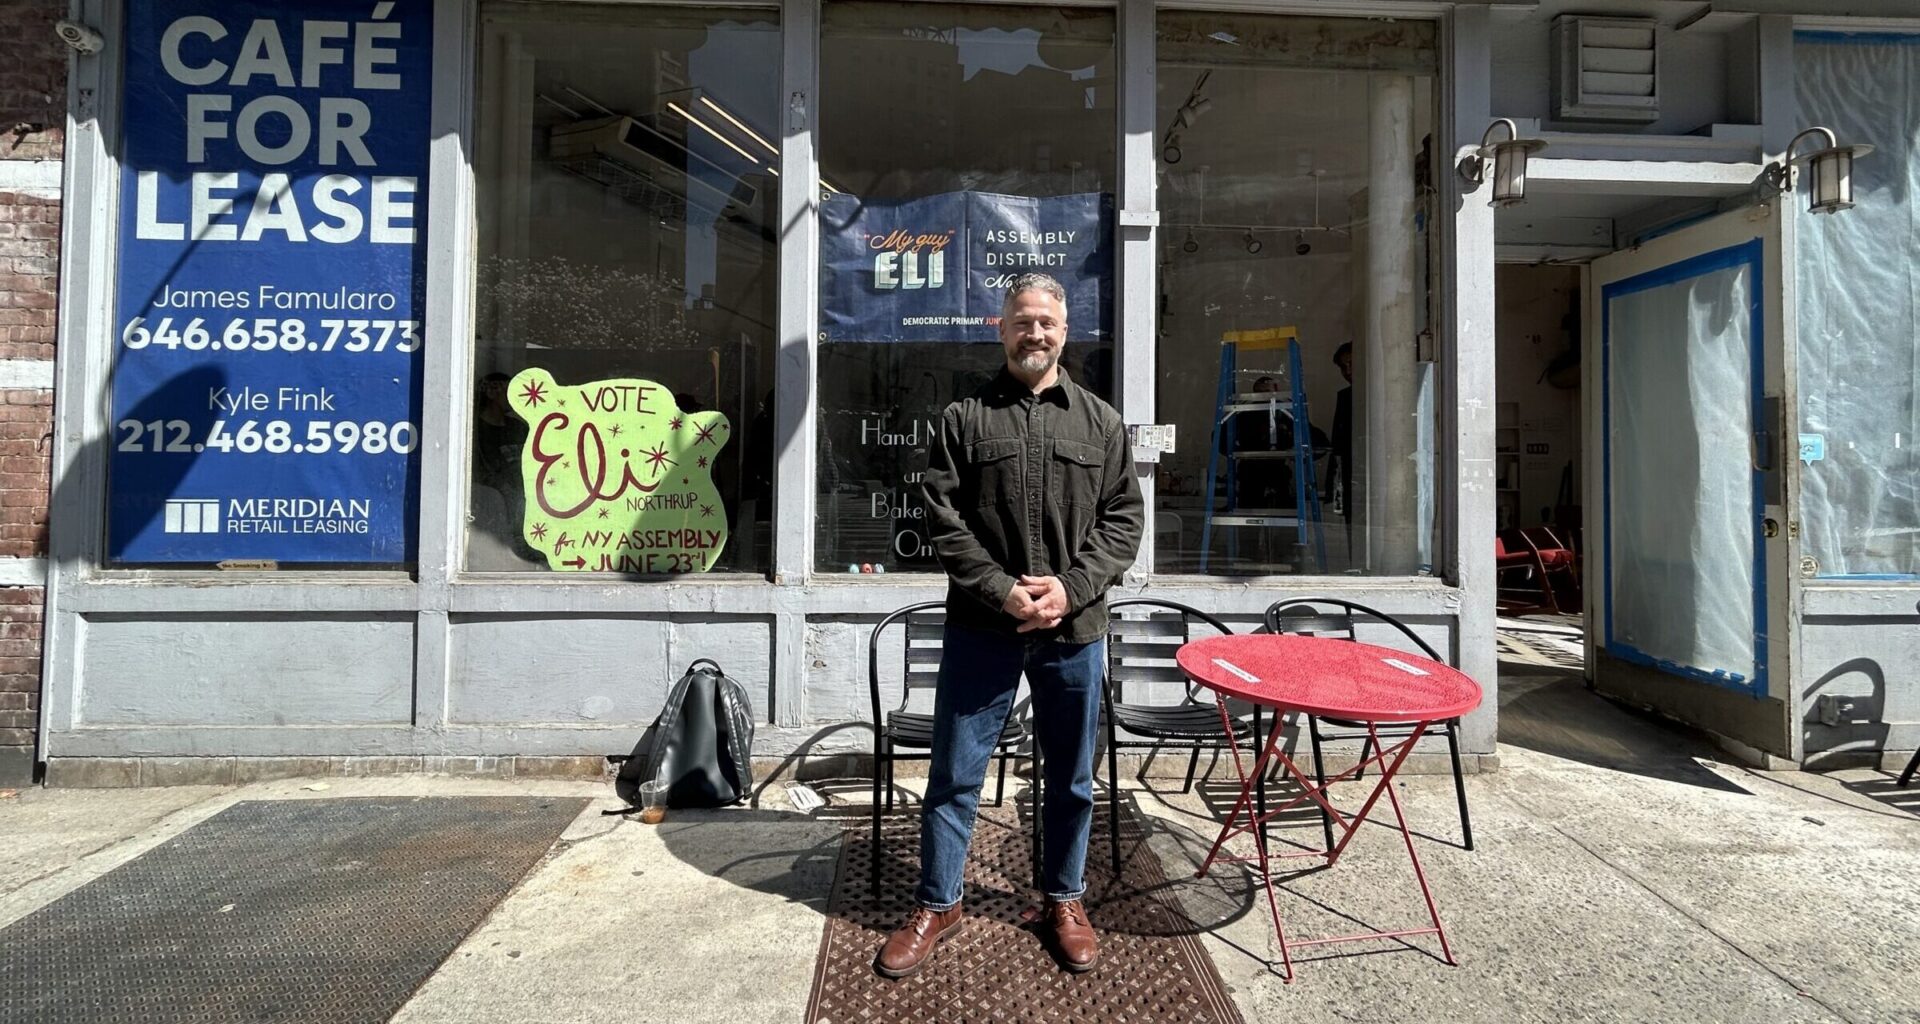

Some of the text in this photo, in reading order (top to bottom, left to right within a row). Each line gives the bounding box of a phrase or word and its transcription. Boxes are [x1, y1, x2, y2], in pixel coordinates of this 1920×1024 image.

[160, 2, 401, 90] CAFÉ
[186, 94, 377, 167] FOR
[136, 170, 417, 244] LEASE
[986, 230, 1076, 245] ASSEMBLY
[874, 250, 944, 290] ELI
[986, 252, 1067, 267] DISTRICT
[153, 286, 396, 311] James Famularo
[122, 317, 420, 353] 646.658.7373
[902, 316, 950, 327] DEMOCRATIC
[951, 316, 984, 326] PRIMARY
[209, 387, 335, 415] Kyle Fink
[580, 386, 657, 415] VOTE
[118, 420, 418, 455] 212.468.5980
[861, 418, 917, 446] Hand
[532, 412, 662, 520] Eli
[227, 499, 370, 519] MERIDIAN
[626, 492, 698, 513] NORTHRUP
[872, 492, 927, 519] Bake
[227, 519, 369, 534] RETAIL LEASING
[554, 529, 720, 556] for NY ASSEMBLY
[591, 552, 661, 573] JUNE
